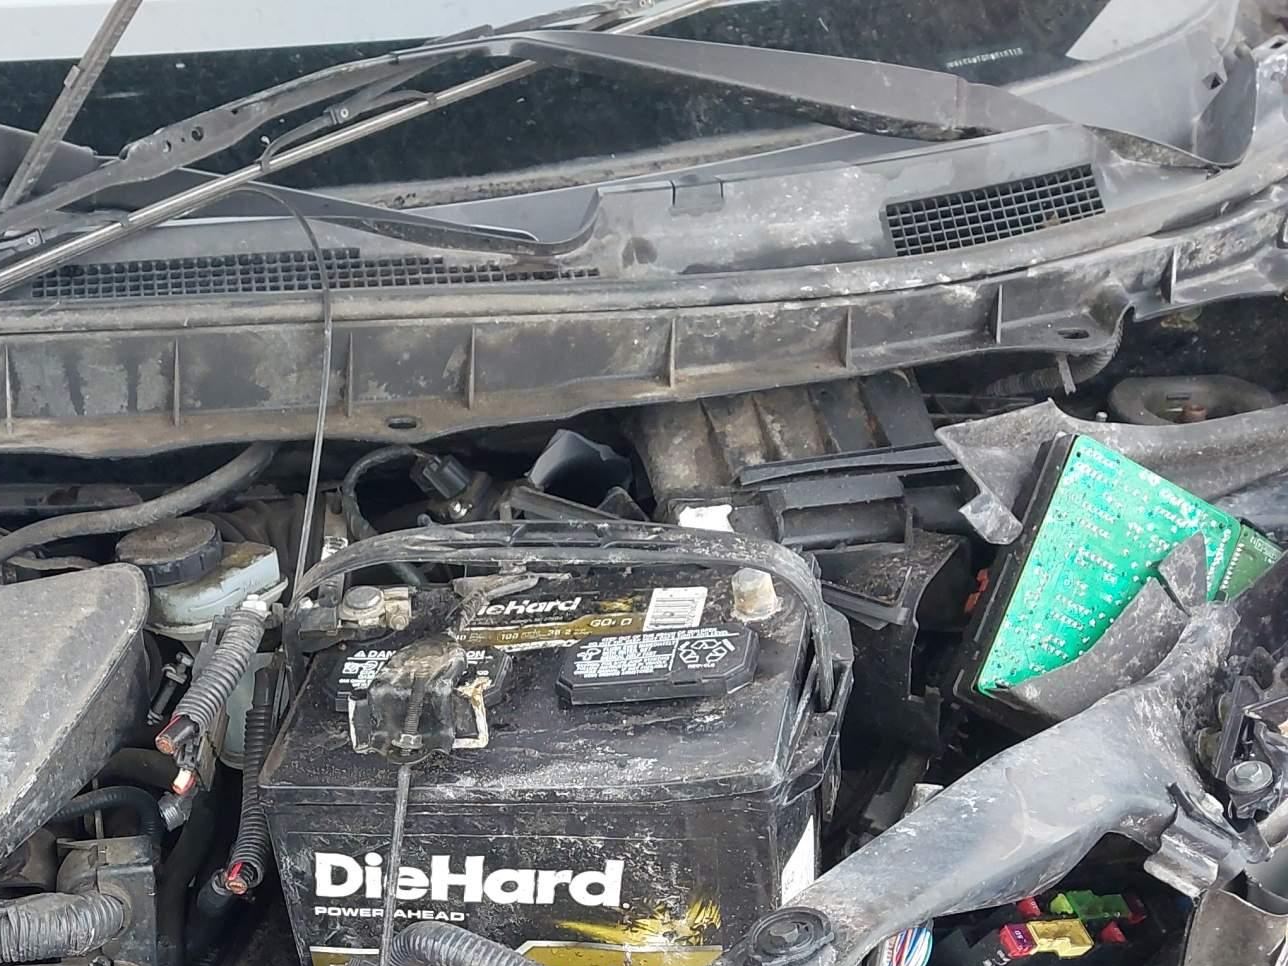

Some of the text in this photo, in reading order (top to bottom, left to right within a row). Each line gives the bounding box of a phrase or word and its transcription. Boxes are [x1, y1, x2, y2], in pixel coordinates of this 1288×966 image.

[589, 617, 634, 628] GOD
[314, 907, 465, 921] POWER AHEAD
